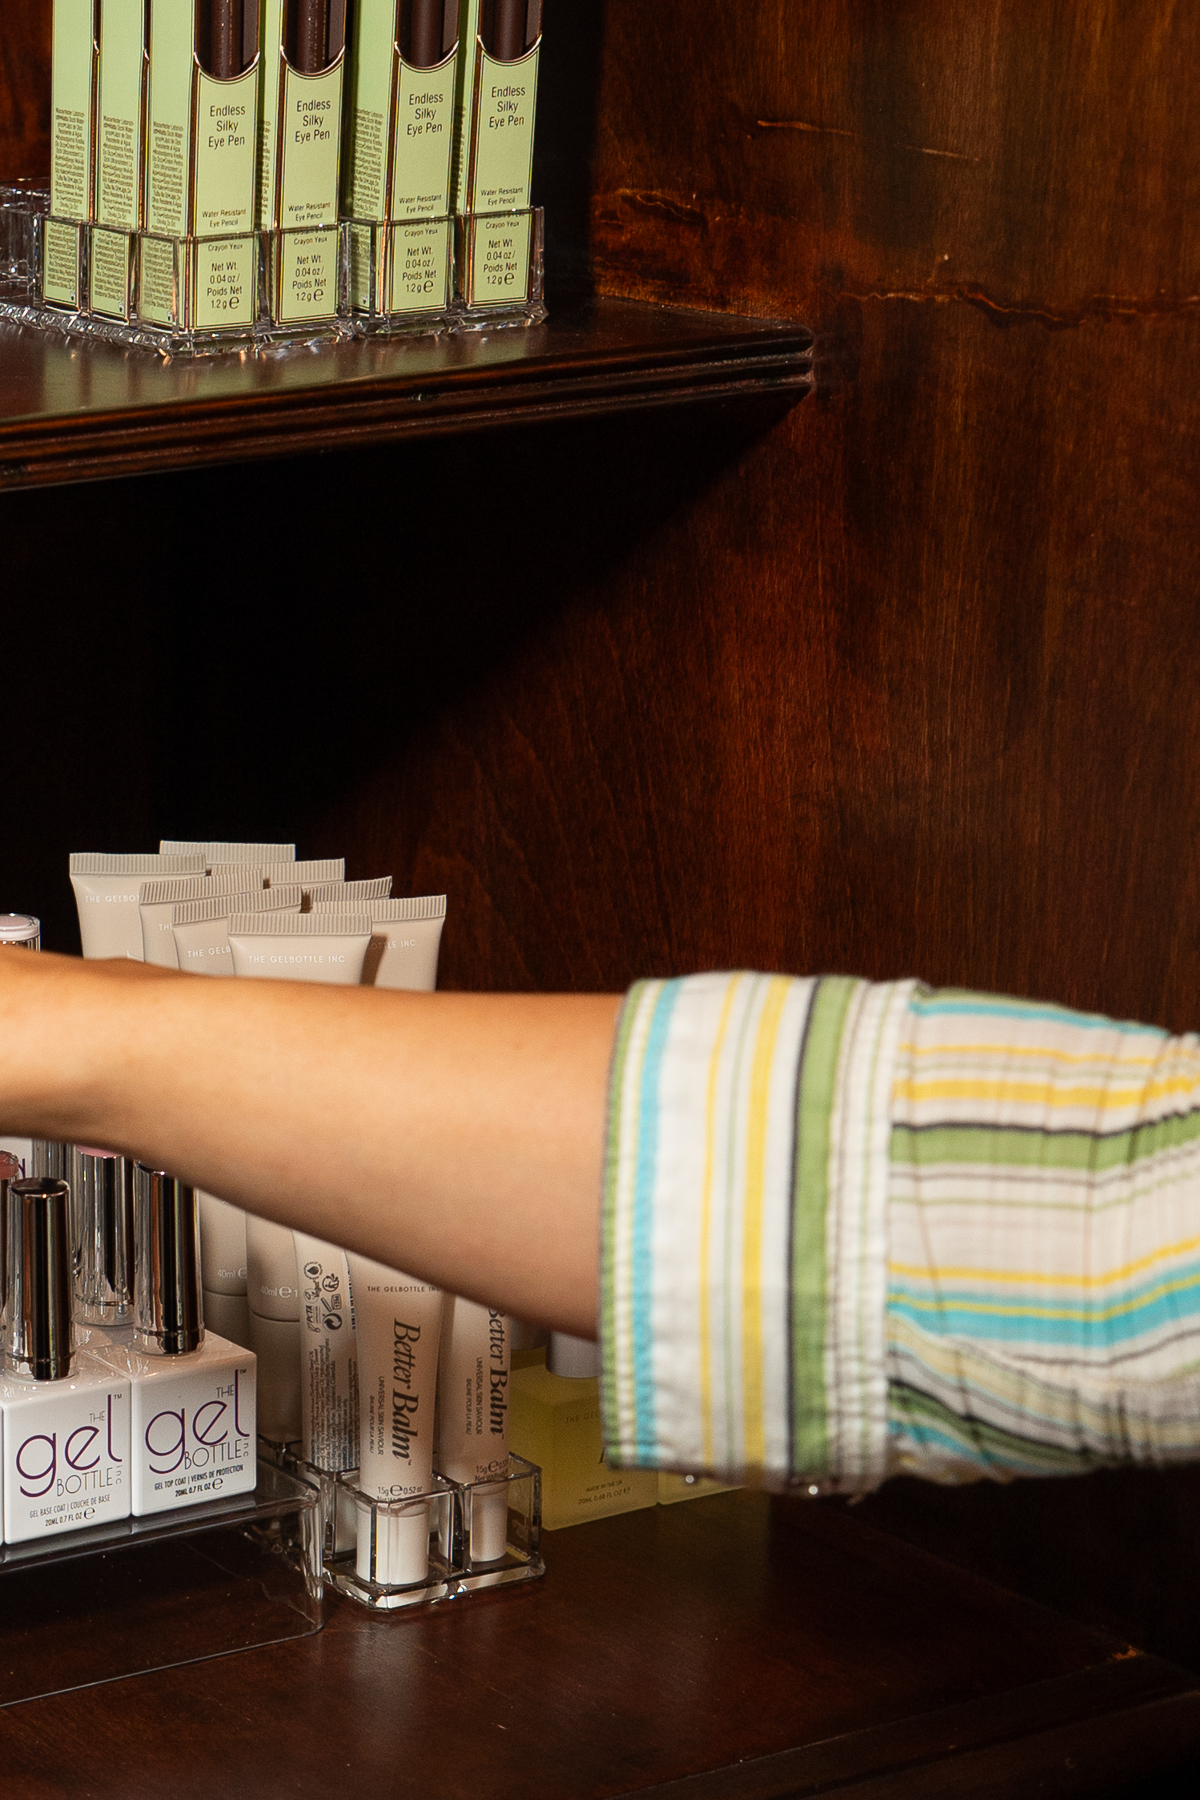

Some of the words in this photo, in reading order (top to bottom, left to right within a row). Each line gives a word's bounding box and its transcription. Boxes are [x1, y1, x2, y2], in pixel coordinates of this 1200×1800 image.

[492, 86, 525, 98] Endless
[409, 93, 443, 105] Endless
[210, 105, 246, 117] Endless
[297, 100, 331, 112] Endless
[497, 101, 519, 113] Silky
[415, 108, 436, 120] Silky
[216, 120, 239, 133] Silky
[303, 115, 324, 127] Silky
[489, 116, 504, 130] Eye
[508, 115, 524, 126] Pen
[407, 124, 422, 137] Eye
[426, 122, 442, 133] Pen
[209, 136, 225, 150] Eye
[228, 135, 245, 146] Pen
[295, 131, 310, 144] Eye
[314, 129, 330, 140] Pen
[499, 187, 523, 195] Resistant
[417, 195, 441, 203] Resistant
[499, 196, 515, 204] Pencil
[288, 204, 304, 212] Water
[306, 202, 330, 210] Resistant
[202, 210, 219, 218] Water
[221, 209, 246, 217] Resistant
[307, 212, 323, 220] Pencil
[489, 240, 500, 249] Net
[407, 248, 419, 256] Net
[297, 256, 308, 265] Net
[211, 263, 224, 272] Net
[484, 264, 503, 273] Poids
[505, 262, 517, 271] Net
[403, 272, 422, 281] Poids
[425, 270, 436, 278] Net
[292, 280, 312, 289] Poids
[315, 279, 326, 287] Net
[207, 287, 227, 296] Poids
[230, 286, 242, 294] Net
[401, 939, 416, 948] INC
[188, 949, 203, 958] THE
[249, 955, 265, 963] THE
[270, 955, 324, 963] GELBOTTLE
[328, 955, 346, 963] INC
[218, 1270, 235, 1278] 40ml
[393, 1318, 421, 1390] Better
[216, 1384, 234, 1398] THE
[490, 1369, 507, 1434] Balm
[89, 1411, 105, 1423] THE
[145, 1369, 250, 1474] gel
[392, 1388, 419, 1460] Balm
[16, 1394, 122, 1498] gel
[184, 1438, 241, 1469] BOTTLE
[57, 1467, 113, 1496] BOTTLE
[165, 1480, 173, 1488] TOP
[175, 1477, 186, 1486] COAT
[191, 1472, 207, 1482] VERNIS
[209, 1470, 215, 1478] DE
[216, 1464, 243, 1476] PROTECTION
[175, 1488, 187, 1497] 20ML
[204, 1482, 211, 1490] OZ
[30, 1510, 38, 1518] GEL
[40, 1507, 52, 1515] BASE
[54, 1504, 66, 1513] COAT
[71, 1500, 89, 1509] COUCHE
[91, 1497, 97, 1505] DE
[98, 1494, 110, 1503] BASE
[45, 1518, 58, 1526] 20ML
